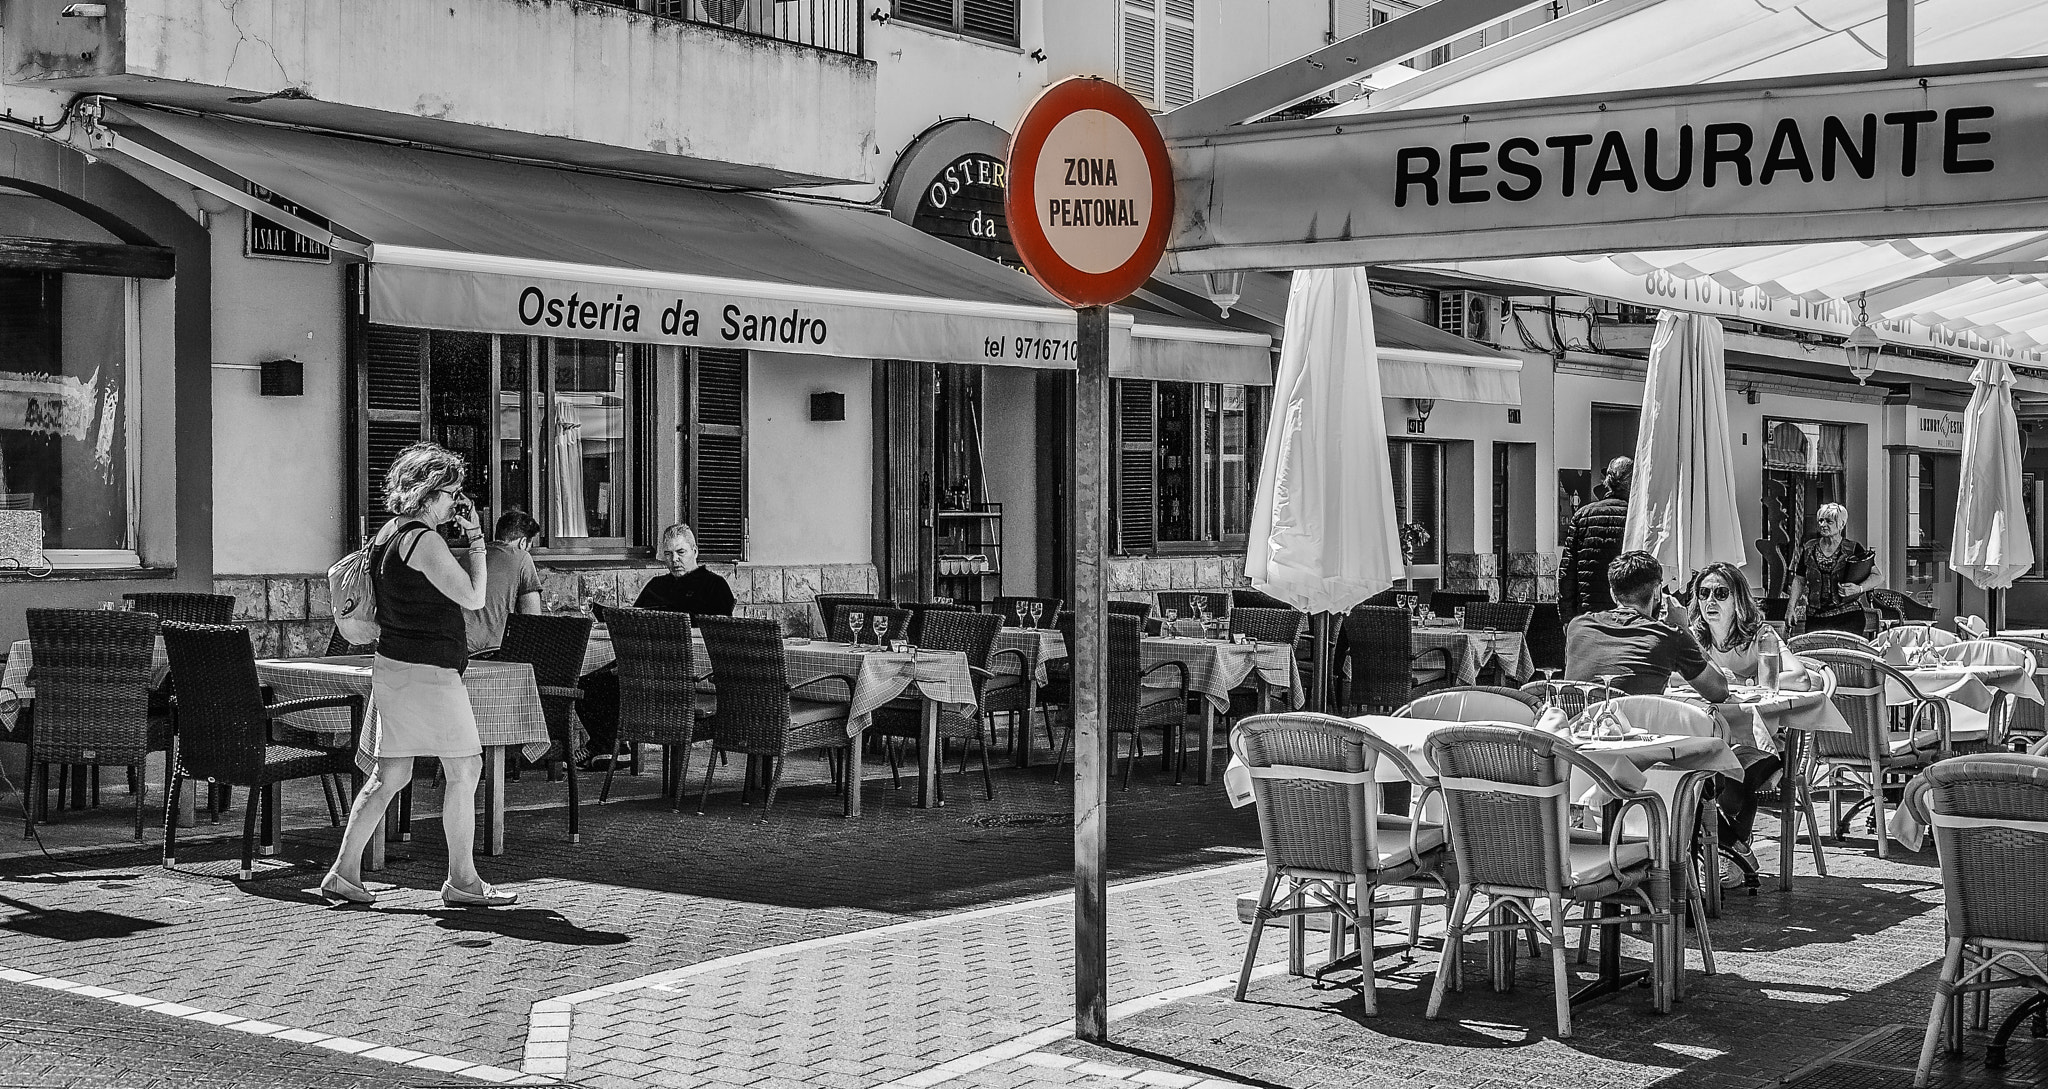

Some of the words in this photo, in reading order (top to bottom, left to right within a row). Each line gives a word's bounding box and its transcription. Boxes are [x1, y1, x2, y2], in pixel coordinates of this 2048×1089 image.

[1394, 105, 1995, 208] RESTAURANTE
[1064, 158, 1118, 186] ZONA
[971, 210, 996, 237] da
[1049, 199, 1138, 226] PEATONAL
[254, 228, 287, 251] ISAAC
[518, 286, 641, 332] Osteria
[660, 299, 700, 337] da
[721, 304, 827, 345] Sandro
[984, 336, 1005, 357] tel
[1015, 336, 1077, 361] 9716710
